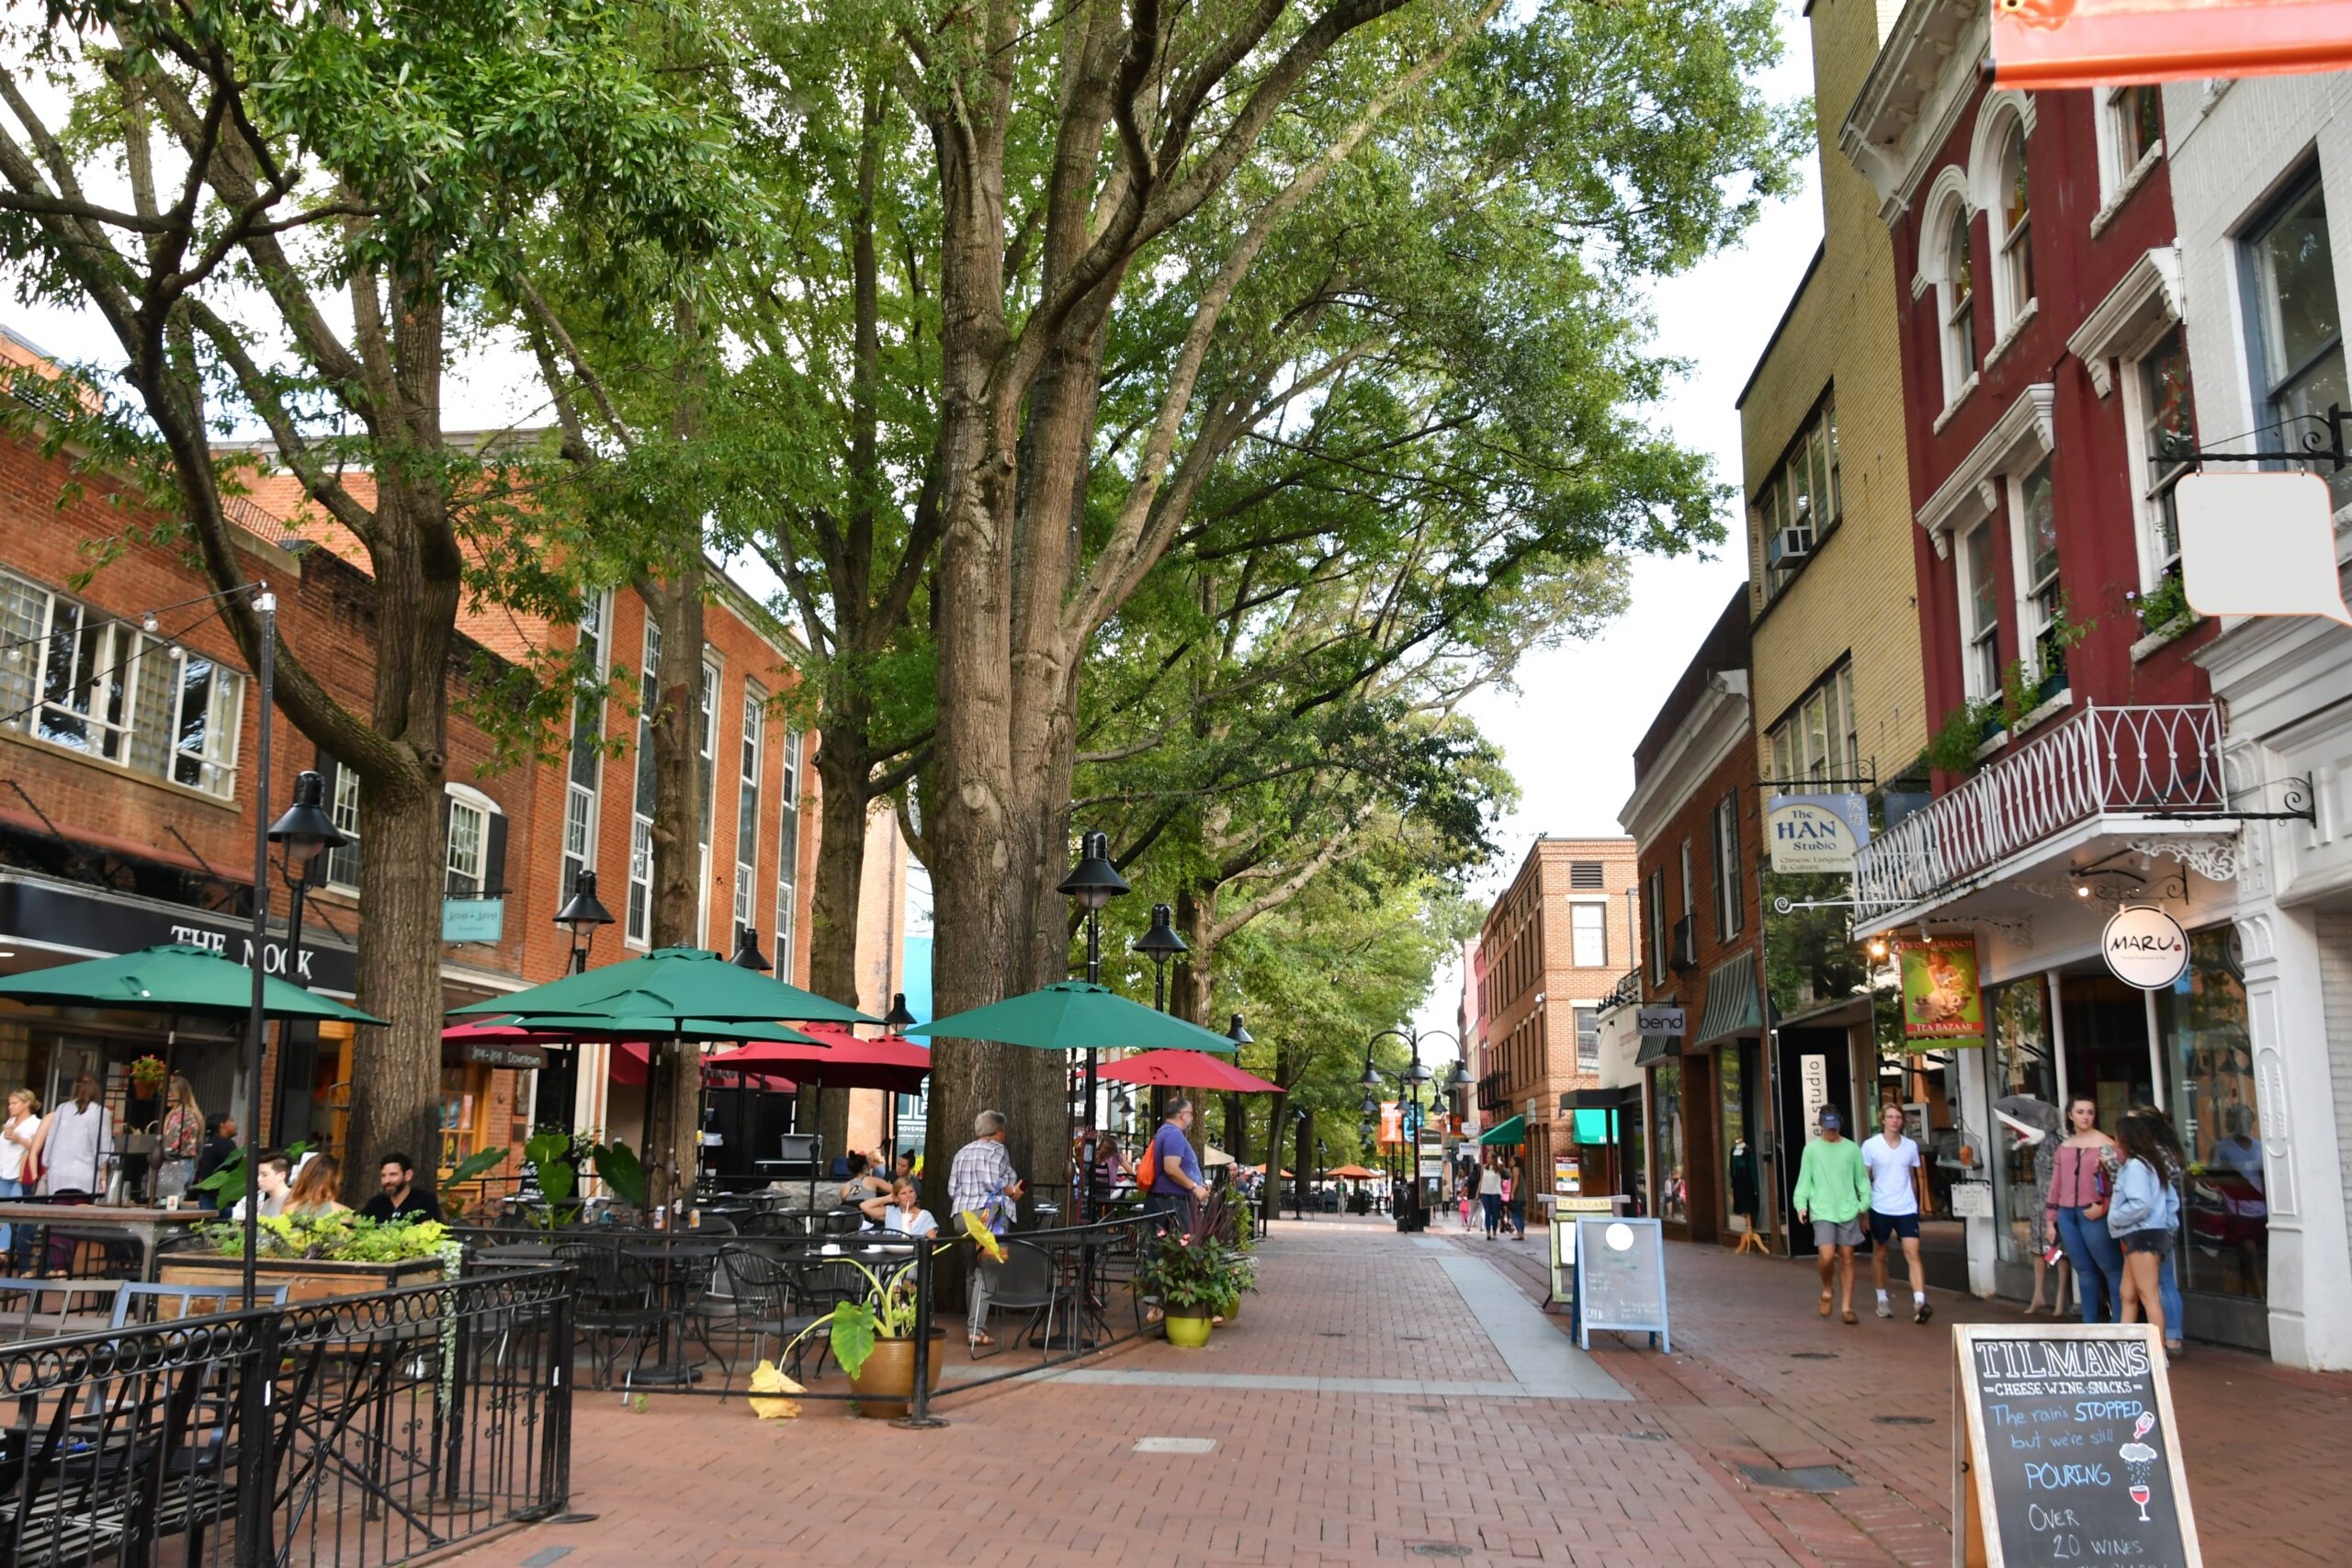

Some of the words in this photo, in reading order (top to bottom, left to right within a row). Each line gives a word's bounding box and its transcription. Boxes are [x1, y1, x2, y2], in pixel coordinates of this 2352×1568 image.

[1791, 810, 1815, 818] The
[1777, 820, 1837, 840] HAN
[1792, 841, 1837, 851] Studio
[1938, 940, 1973, 948] BRANCH
[2110, 935, 2175, 951] MARU
[1638, 1012, 1683, 1030] bend
[1917, 1023, 1933, 1032] TEA
[1935, 1022, 1973, 1031] BAZAAR
[1805, 1060, 1823, 1113] studio
[1558, 1199, 1574, 1208] TEA
[1576, 1199, 1611, 1208] BAZAAR
[1975, 1341, 2151, 1378] TILMANS
[1988, 1404, 2026, 1426] The
[2074, 1400, 2143, 1422] STOPPED
[2010, 1430, 2041, 1449] but
[2050, 1432, 2085, 1448] we're
[2090, 1429, 2115, 1445] still
[2024, 1462, 2111, 1489] POURING
[2029, 1503, 2081, 1532] OVER
[2052, 1533, 2081, 1559] 20
[2090, 1538, 2144, 1556] WINES
